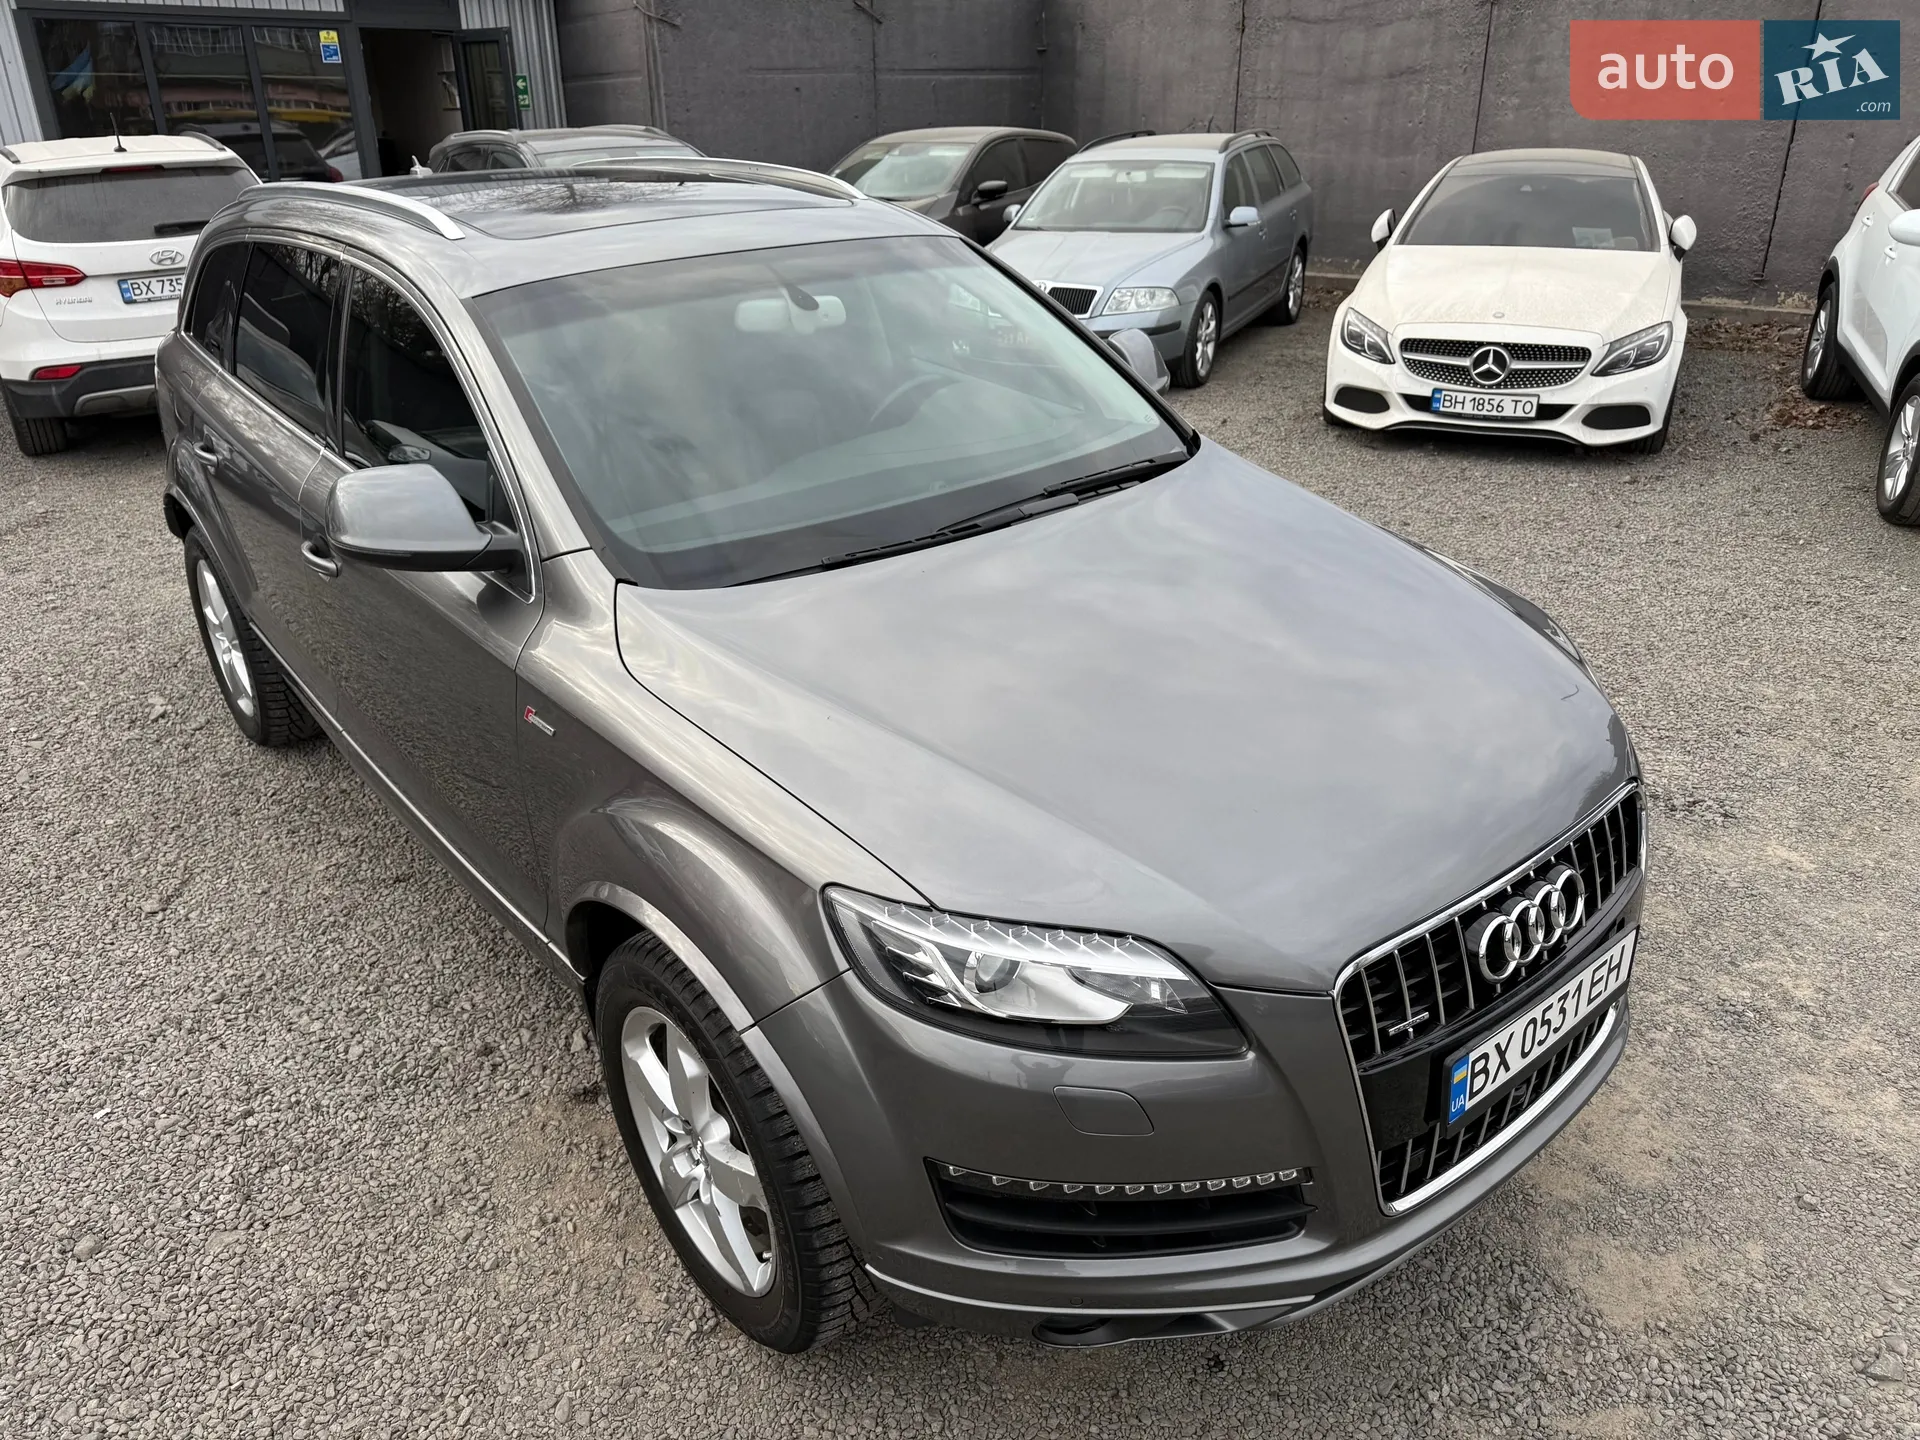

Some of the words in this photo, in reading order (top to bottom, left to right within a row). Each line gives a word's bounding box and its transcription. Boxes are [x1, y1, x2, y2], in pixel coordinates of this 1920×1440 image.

[130, 281, 155, 296] BX
[1442, 394, 1466, 410] BH
[1469, 397, 1504, 413] 1856
[1511, 400, 1533, 414] TO
[1451, 1096, 1464, 1112] UA
[1469, 1031, 1515, 1098] BX
[1520, 978, 1584, 1060] 0531
[1587, 944, 1626, 1007] EH
